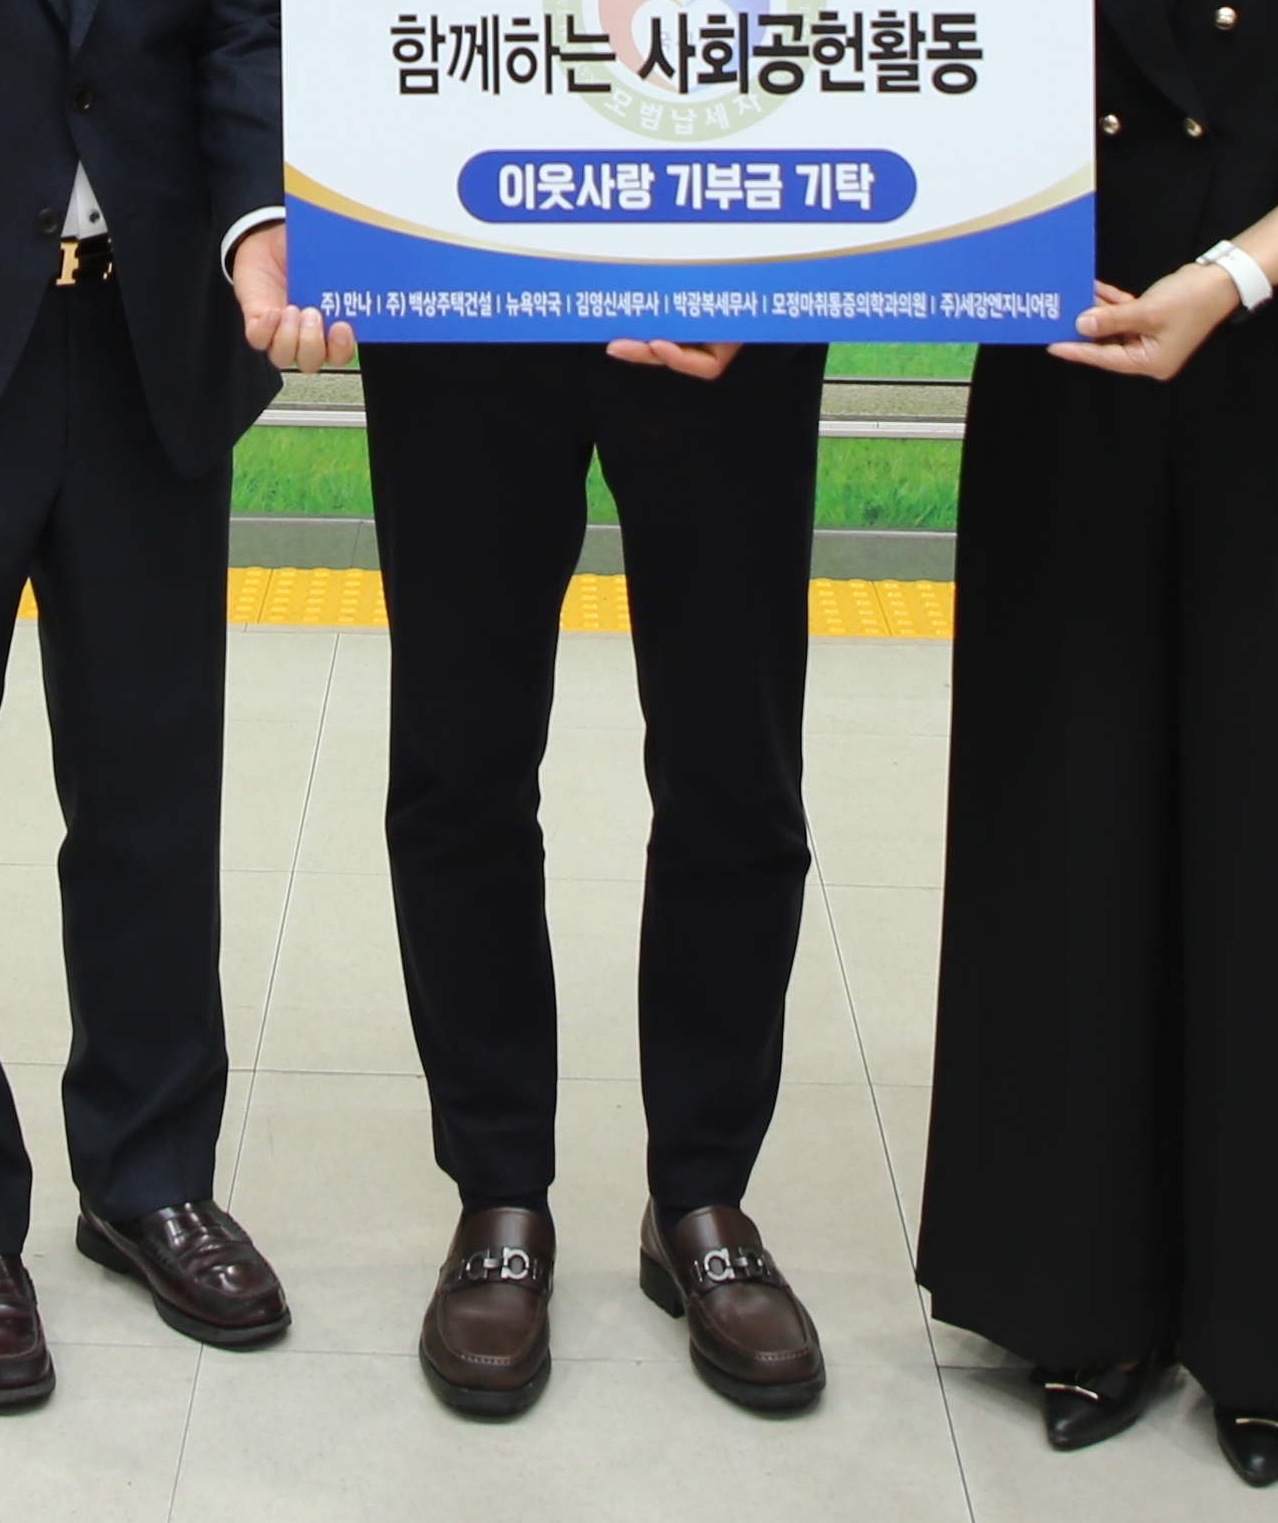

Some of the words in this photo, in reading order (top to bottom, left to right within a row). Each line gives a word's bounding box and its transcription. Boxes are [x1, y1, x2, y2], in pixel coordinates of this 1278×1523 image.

[390, 13, 617, 95] 함께하는
[639, 9, 985, 95] 사회공헌활동
[604, 89, 762, 136] 모범납세자
[499, 163, 656, 210] 이웃사랑
[667, 163, 784, 210] 기부금
[796, 163, 875, 210] 기탁
[342, 291, 372, 317] 만나
[408, 291, 493, 317] 백상주택건설
[506, 291, 563, 317] 뉴욕약국
[576, 291, 660, 318] 김영신세무사
[673, 291, 759, 318] 박광복세무사
[772, 291, 930, 318] 모정마취통증의학과의원
[940, 292, 1060, 320] 주)세강엔지니어링
